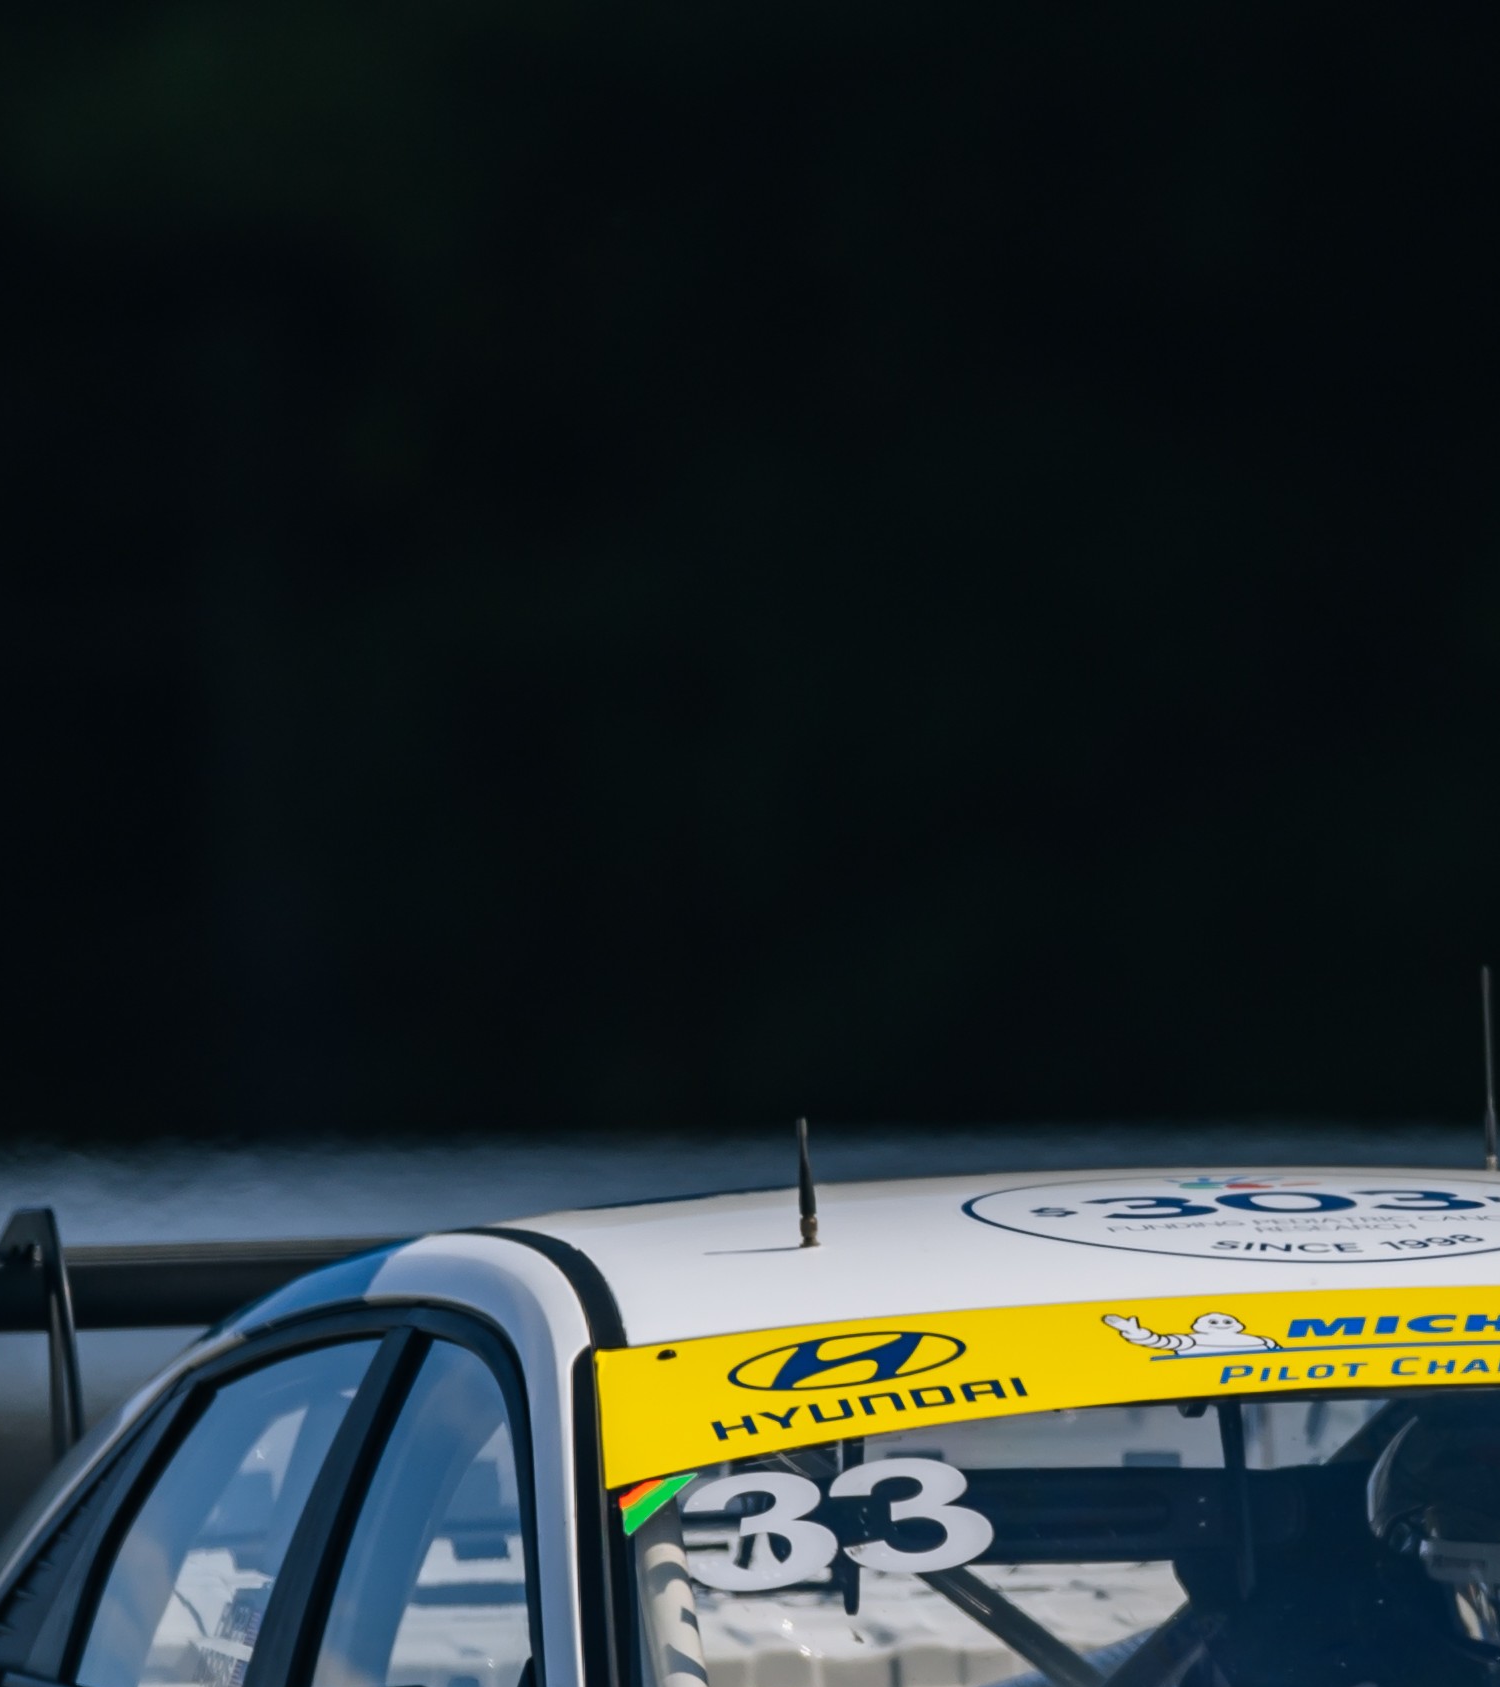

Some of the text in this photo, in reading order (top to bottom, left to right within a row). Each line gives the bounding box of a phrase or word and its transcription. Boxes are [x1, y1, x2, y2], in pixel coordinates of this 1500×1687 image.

[1106, 1219, 1246, 1233] FUNDING
[1252, 1214, 1404, 1226] PEDIATRIC
[1253, 1222, 1418, 1234] RESEARCH
[1210, 1234, 1486, 1254] SINCE 1998
[1219, 1362, 1368, 1385] PILOT
[710, 1376, 1029, 1442] HYUNDAI
[684, 1458, 995, 1592] 33
